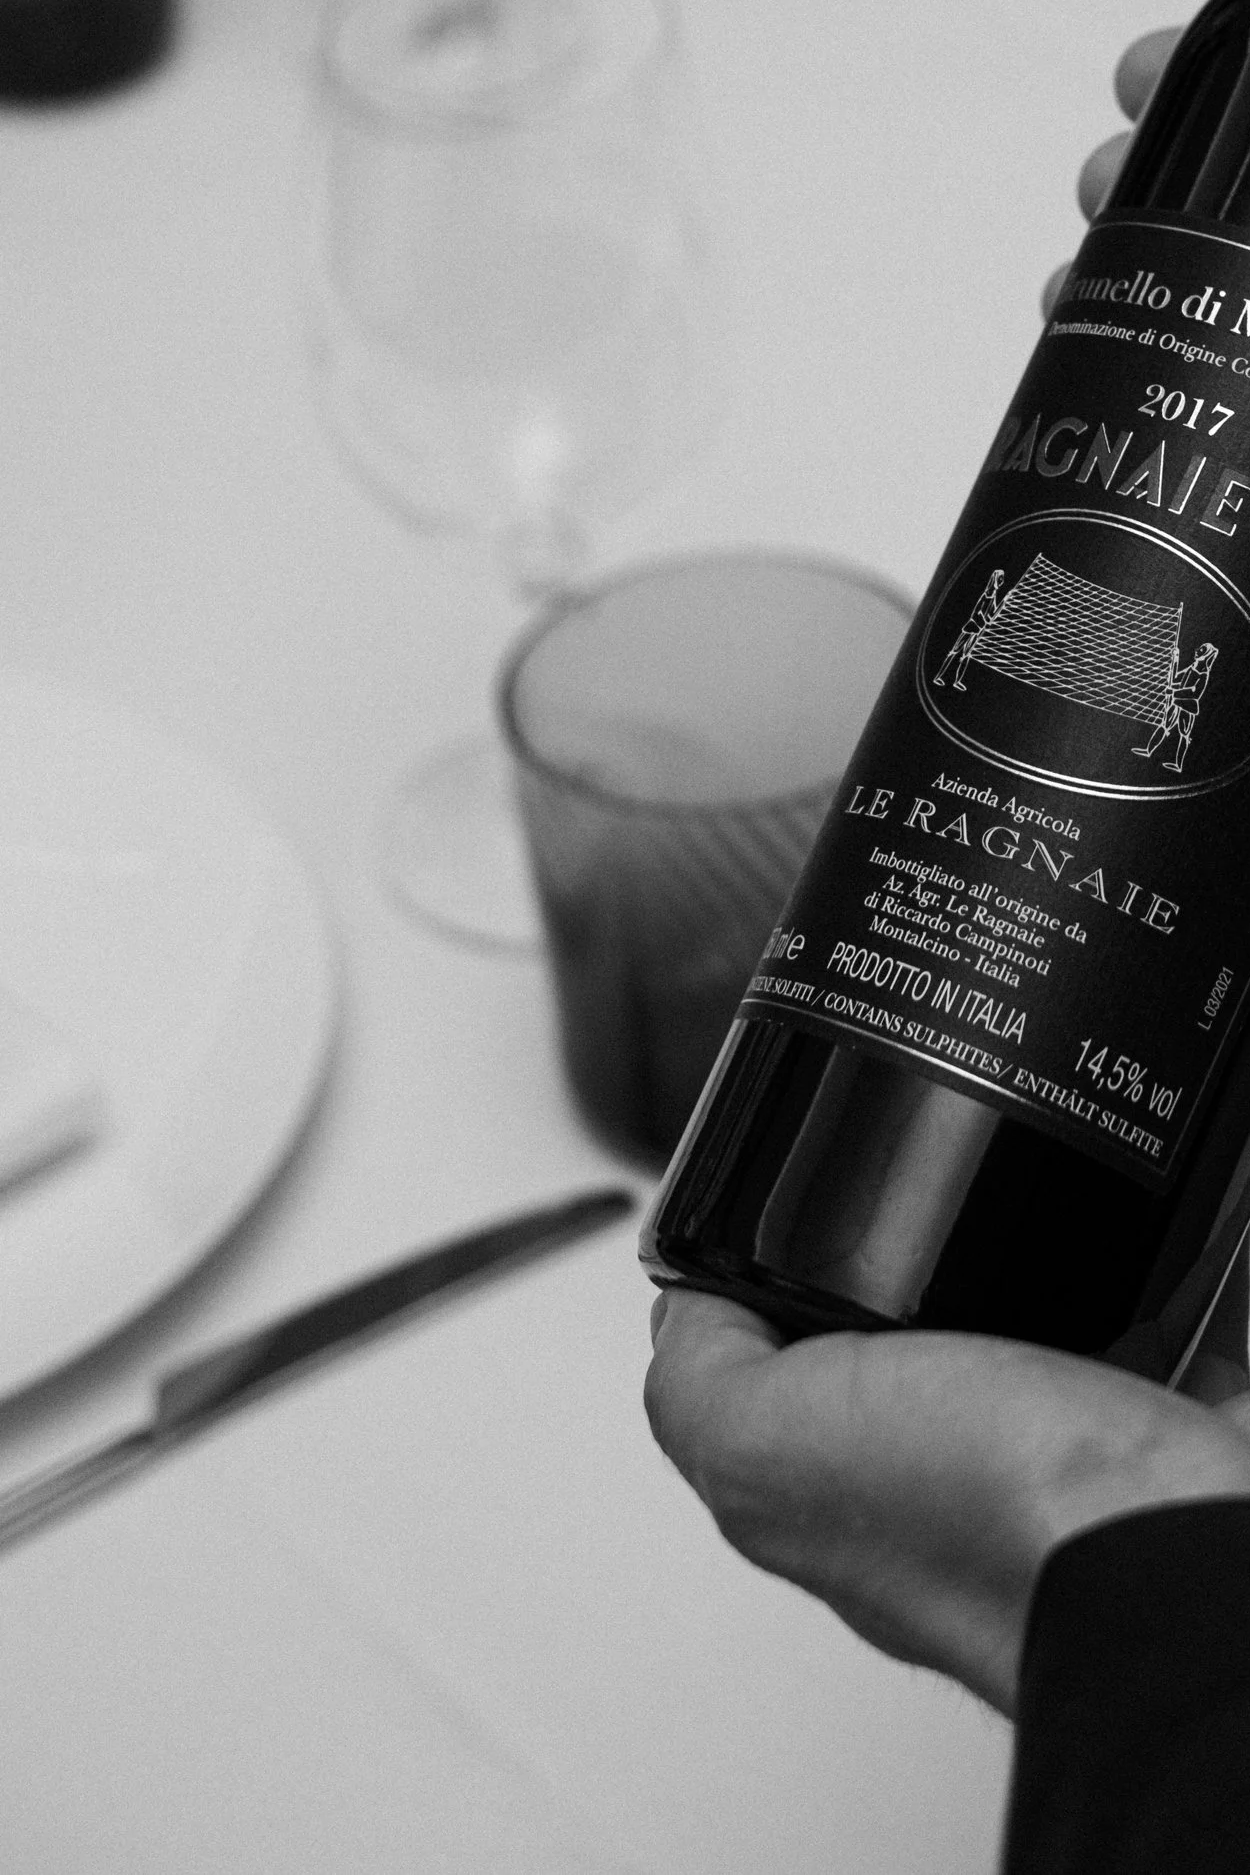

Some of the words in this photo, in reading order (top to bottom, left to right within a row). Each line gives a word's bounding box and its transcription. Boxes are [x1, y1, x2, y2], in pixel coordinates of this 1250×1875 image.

[1181, 286, 1226, 325] di
[1138, 329, 1157, 345] di
[1159, 334, 1226, 367] Origine
[1137, 384, 1235, 436] 2017
[931, 772, 999, 808] Azienda
[1002, 796, 1081, 840] Agricola
[845, 785, 895, 819] LE
[903, 797, 1180, 935] RAGNAIE
[869, 847, 965, 884] Imbottigliato
[1064, 922, 1087, 944] da
[864, 891, 879, 908] di
[881, 896, 951, 933] Riccardo
[955, 923, 1051, 975] Campinoti
[882, 874, 905, 894] Az.
[908, 883, 940, 907] Agr.
[945, 895, 969, 916] Le
[972, 905, 1045, 948] Ragnaie
[868, 915, 960, 961] Montalcino
[974, 954, 1020, 988] Italia
[826, 941, 932, 1001] PRODOTTO
[931, 978, 960, 1013] IN
[958, 989, 1027, 1045] ITALIA
[1204, 966, 1235, 1018] 03/2021
[773, 978, 816, 1001] SOLFITI
[824, 992, 904, 1033] CONTAINS
[1013, 1068, 1099, 1121] ENTHÄLT
[1098, 1110, 1164, 1158] SULFITE
[1075, 1038, 1148, 1103] 14,5%
